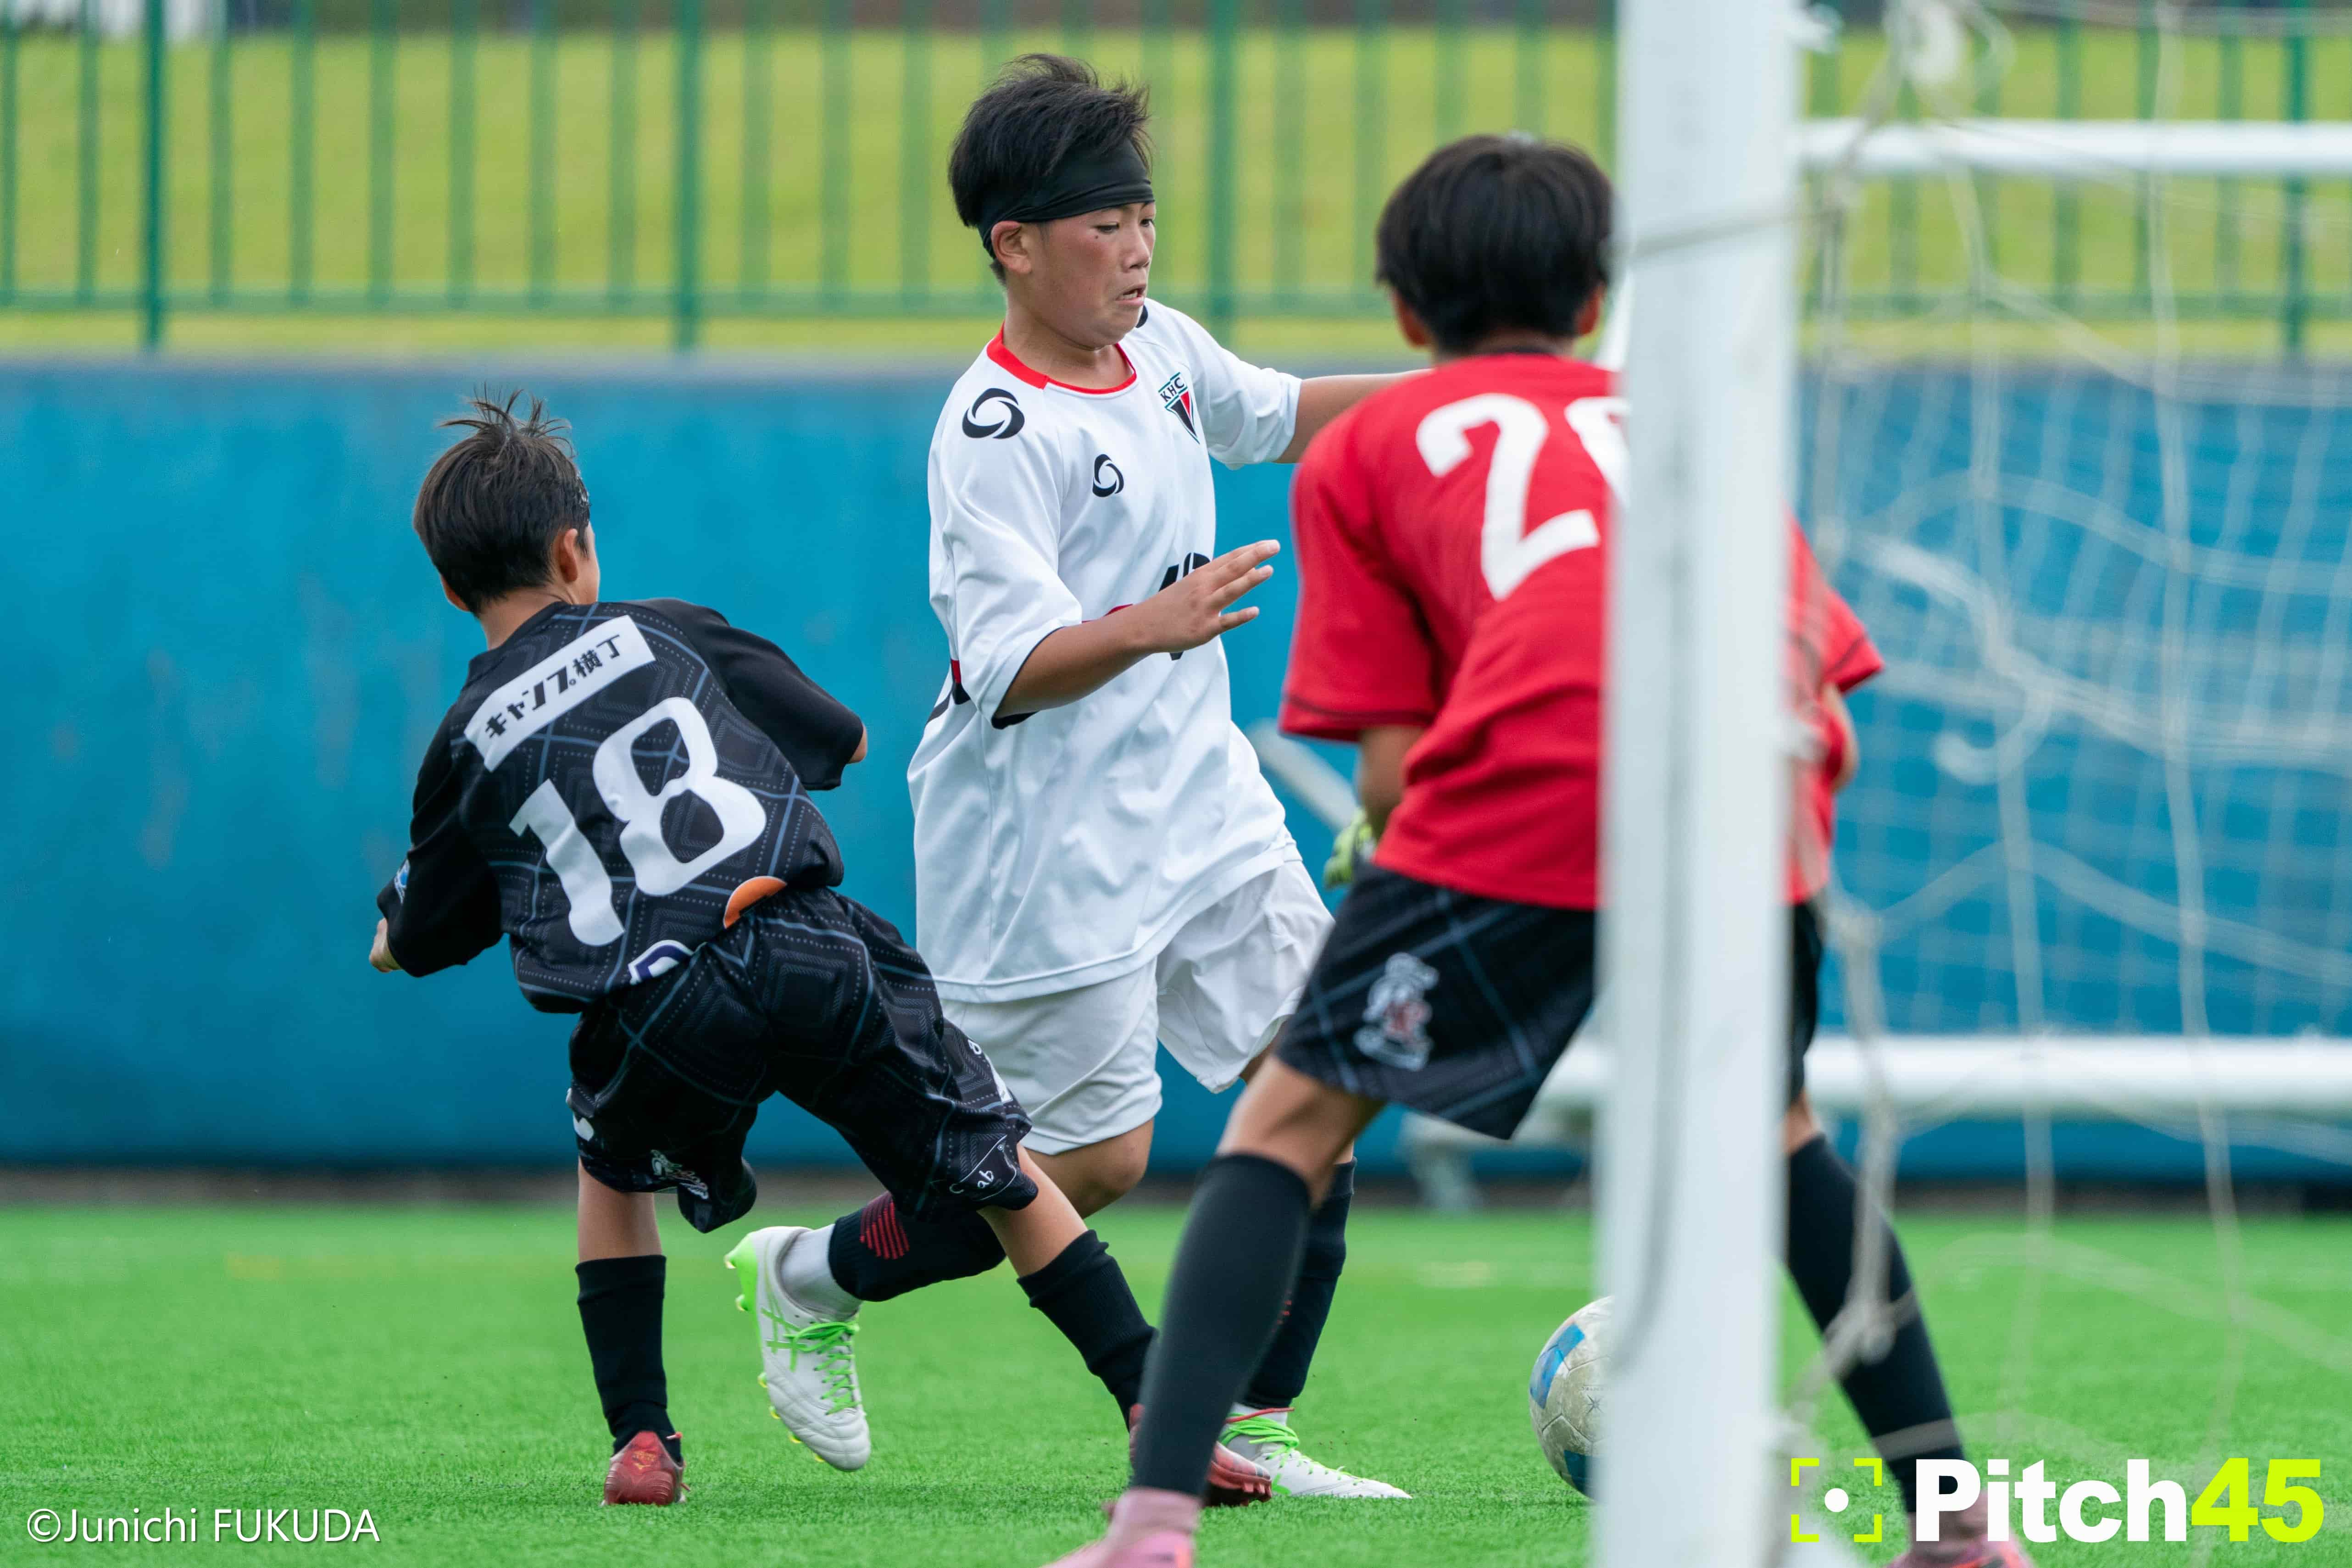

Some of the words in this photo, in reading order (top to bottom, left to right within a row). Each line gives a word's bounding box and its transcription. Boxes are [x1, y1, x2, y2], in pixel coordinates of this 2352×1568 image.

[1160, 377, 1184, 402] KHC
[485, 634, 620, 738] キャンプ横丁
[508, 697, 766, 946] 18
